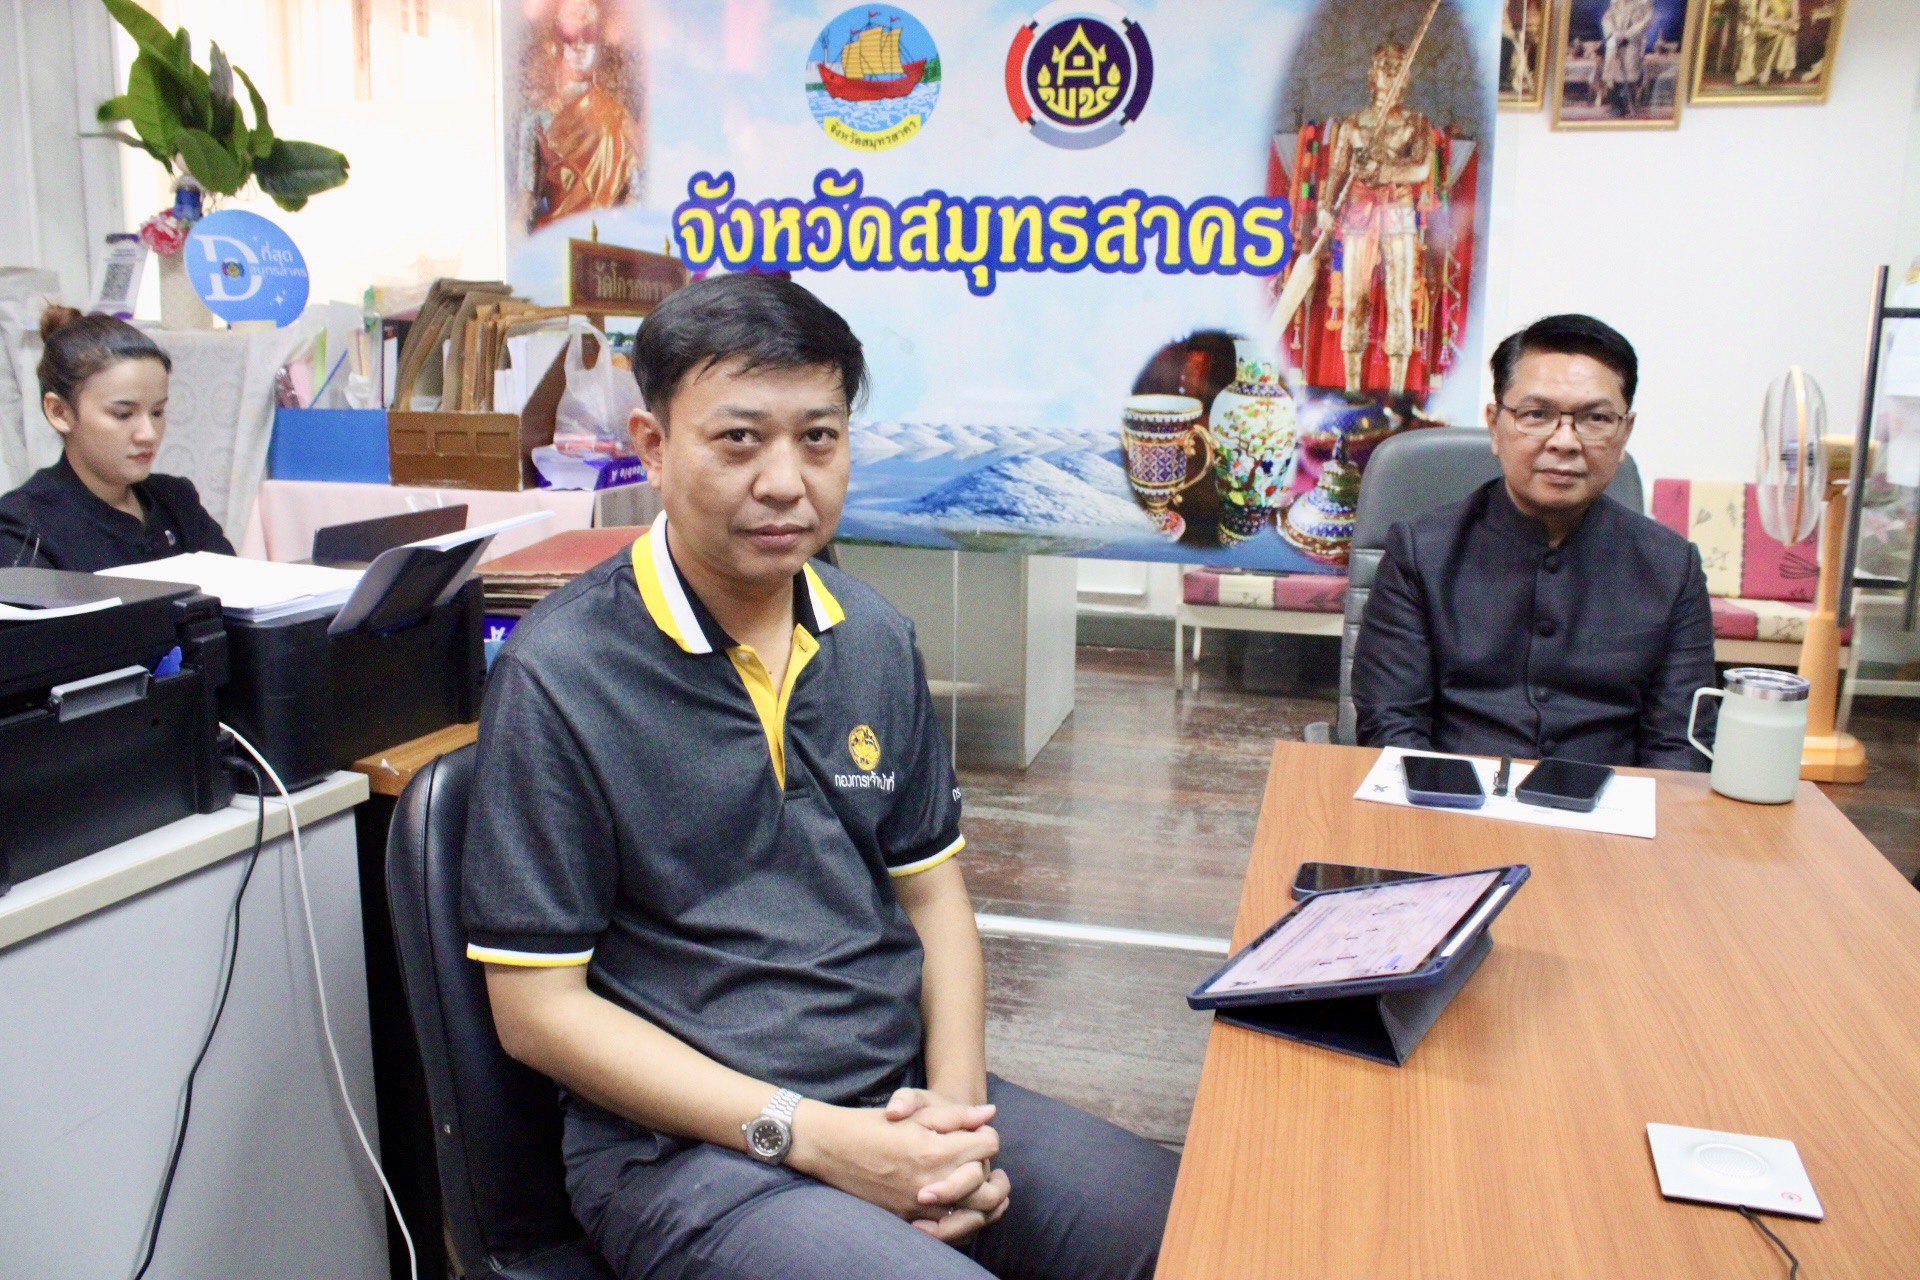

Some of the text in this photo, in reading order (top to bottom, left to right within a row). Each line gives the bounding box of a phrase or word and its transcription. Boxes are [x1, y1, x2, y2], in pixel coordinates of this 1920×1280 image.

[677, 176, 1286, 290] จังหวัดสมุทรสาคร
[834, 770, 895, 791] กองการเจ้าน้าที่
